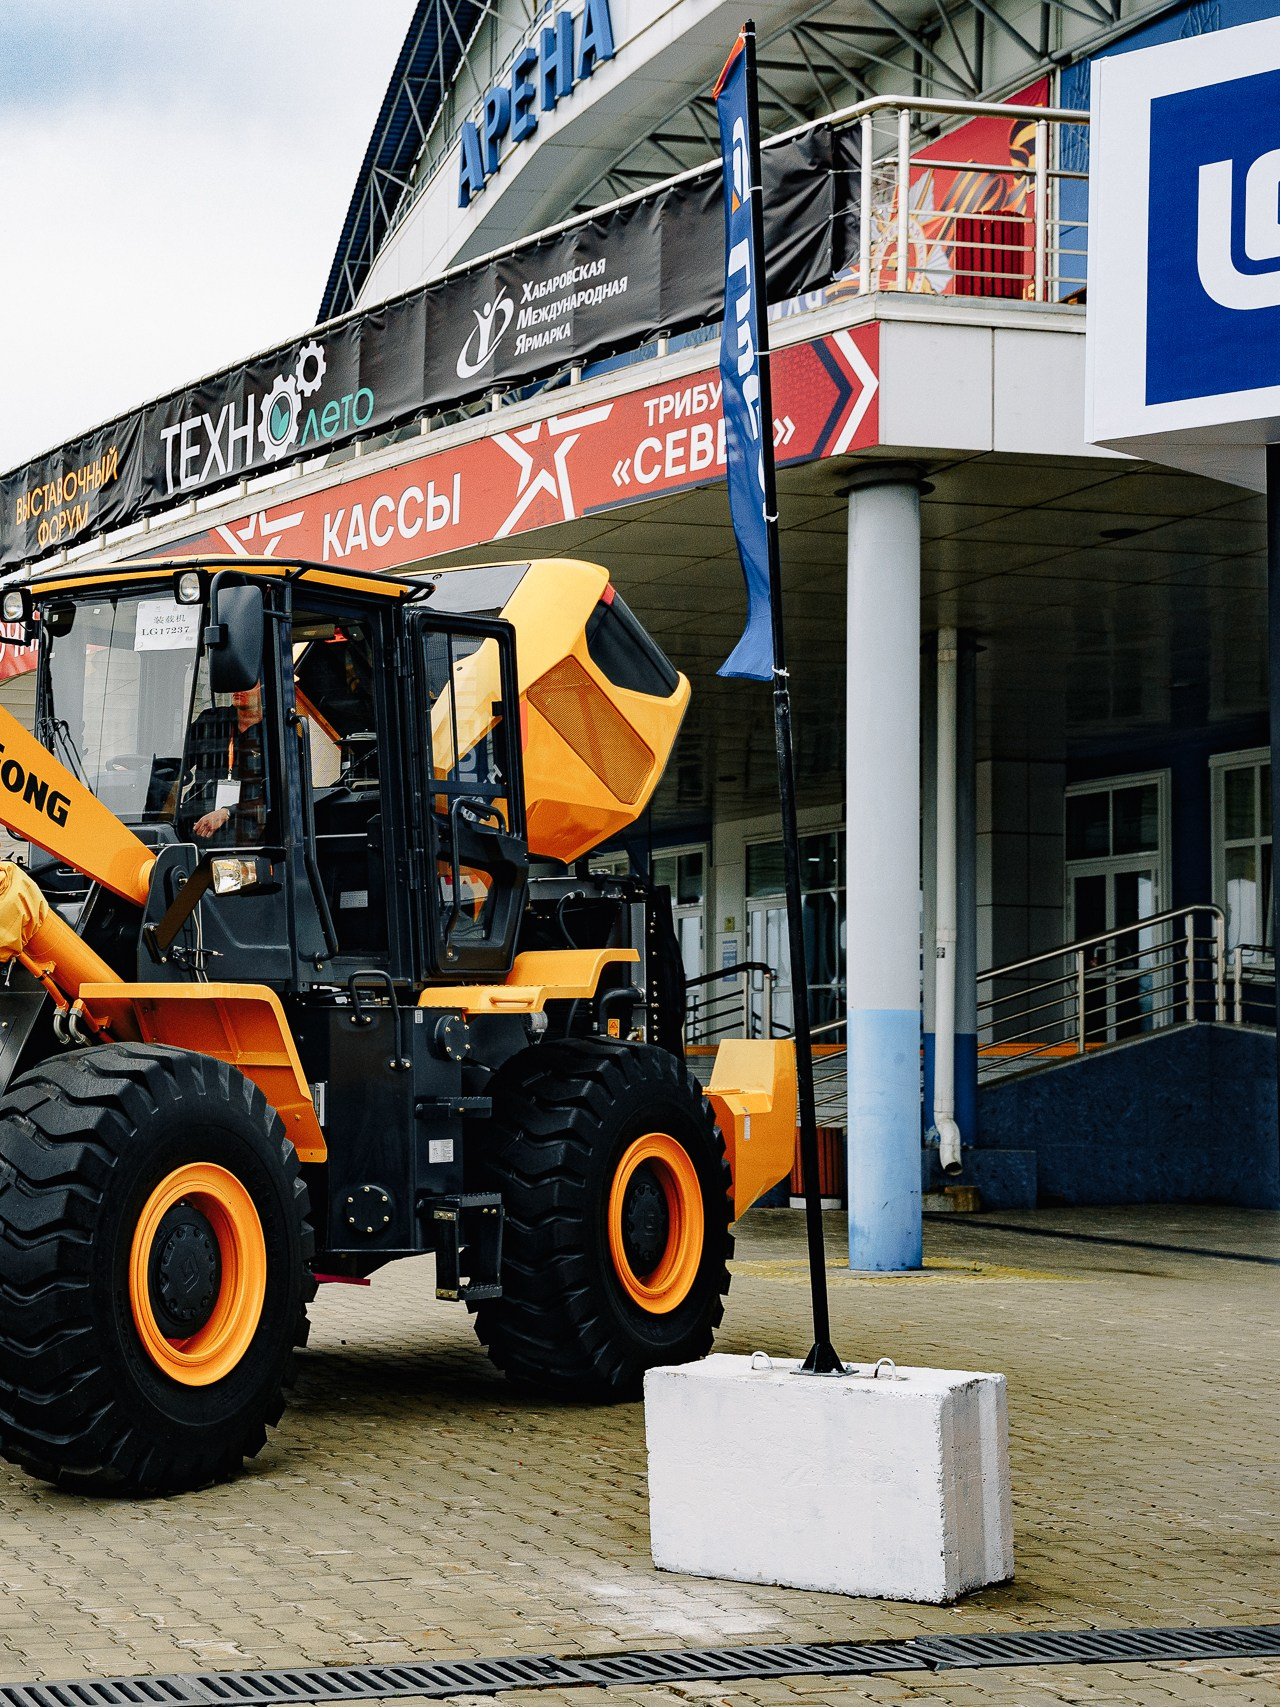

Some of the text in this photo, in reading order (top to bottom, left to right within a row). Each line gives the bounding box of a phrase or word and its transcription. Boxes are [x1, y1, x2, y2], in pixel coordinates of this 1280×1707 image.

[458, 0, 613, 208] АРЕНА
[644, 380, 722, 427] ТРИБУ
[16, 445, 118, 525] ВЫСТАВОЧНЫЙ
[37, 500, 89, 549] ФОРУМ
[322, 472, 461, 562] КАССЫ
